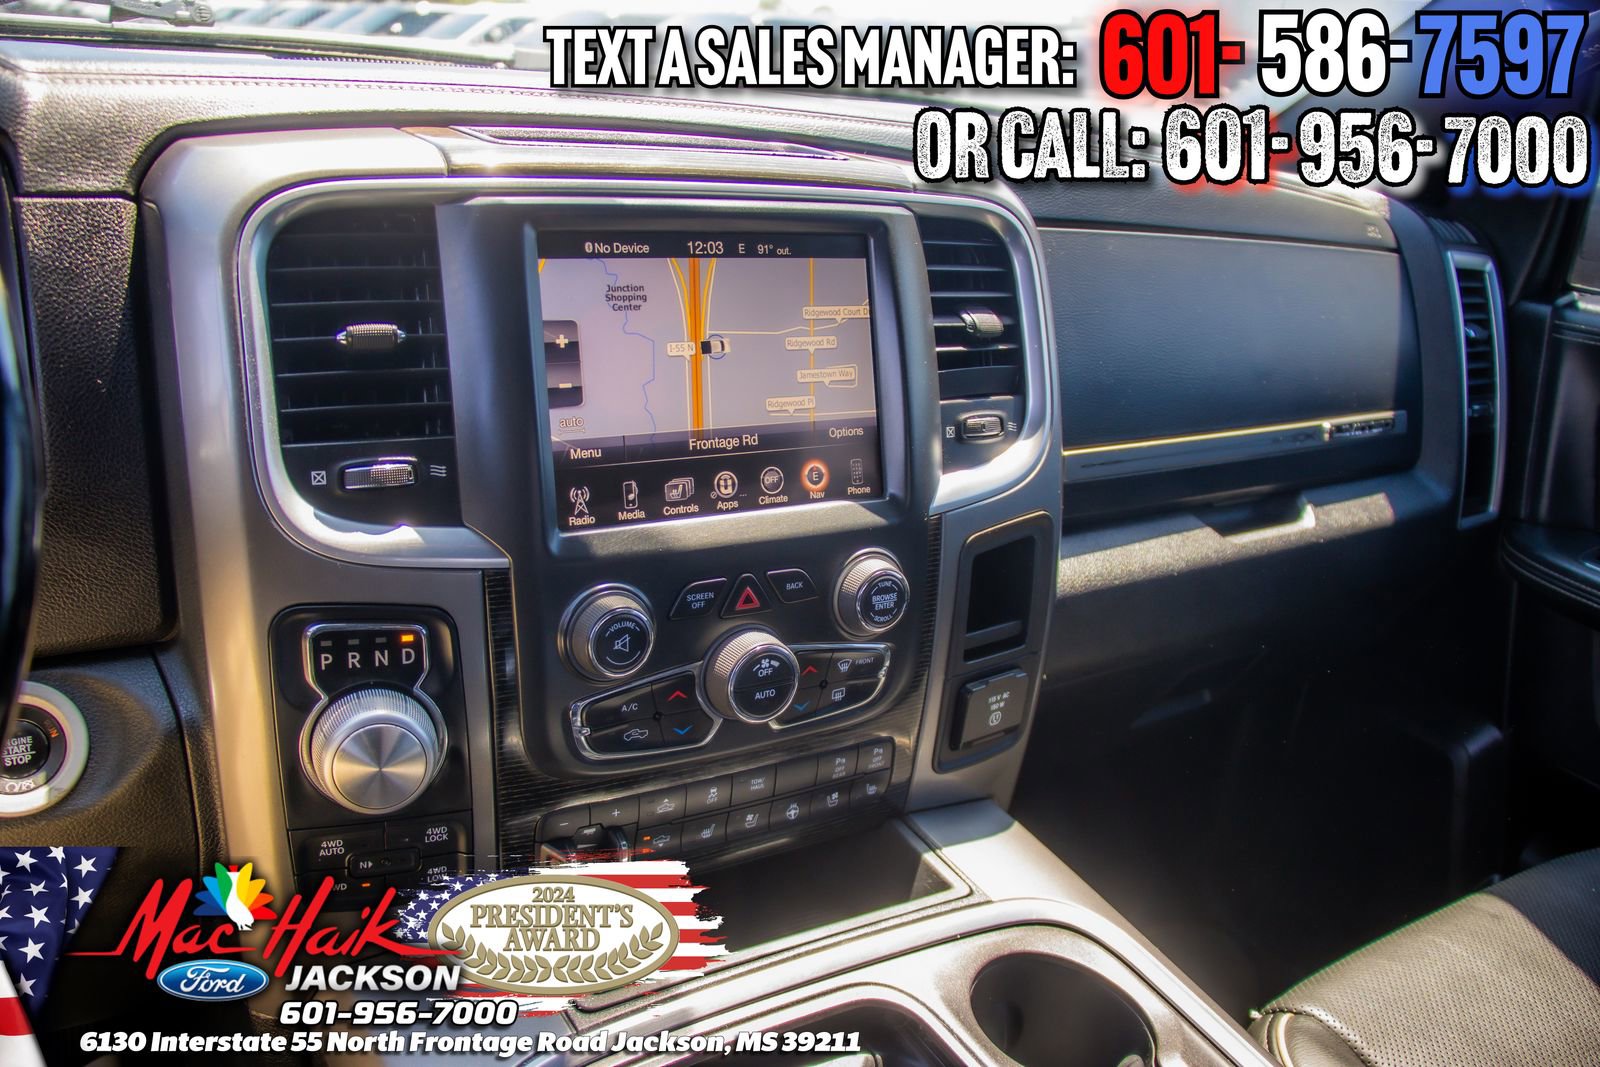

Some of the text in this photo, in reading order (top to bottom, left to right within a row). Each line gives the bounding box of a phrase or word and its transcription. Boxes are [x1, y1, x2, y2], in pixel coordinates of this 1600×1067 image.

[594, 242, 650, 255] No Device
[687, 240, 724, 255] 12:03
[738, 243, 746, 254] E
[776, 246, 792, 256] out.
[605, 284, 645, 294] Junction
[605, 293, 647, 304] Shopping
[612, 302, 642, 312] Center
[804, 308, 841, 317] Ridgewood
[842, 308, 861, 316] Court
[787, 338, 836, 348] Ridgewood Rd
[799, 368, 854, 379] Jamestown Way
[767, 399, 806, 409] Ridgewood
[559, 416, 584, 428] auto
[829, 426, 864, 438] Options
[689, 434, 759, 453] Frontage Rd
[570, 447, 602, 460] Menu
[764, 475, 779, 486] OFF
[809, 490, 825, 500] Nav
[847, 486, 871, 496] Phone
[758, 495, 788, 505] Climate
[663, 504, 699, 516] Controls
[717, 500, 739, 512] Apps
[568, 515, 596, 527] Radio
[618, 510, 646, 522] Media
[786, 581, 804, 591] BACK
[686, 592, 715, 602] SCREEN
[872, 592, 898, 603] BROWSE
[691, 600, 706, 610] OFF
[874, 602, 895, 611] ENTER
[608, 621, 637, 634] VOLUME
[348, 652, 361, 669] R
[374, 650, 390, 667] N
[402, 648, 416, 665] D
[855, 656, 875, 666] FRONT
[321, 654, 334, 671] P
[758, 668, 774, 678] OFF
[754, 688, 776, 700] AUTO
[621, 702, 639, 713] A/C
[4, 755, 32, 767] STOP
[426, 826, 448, 835] 4WD
[425, 832, 449, 843] LOCK
[320, 839, 344, 848] 4WD
[319, 846, 345, 856] AUTO
[359, 861, 367, 869] N
